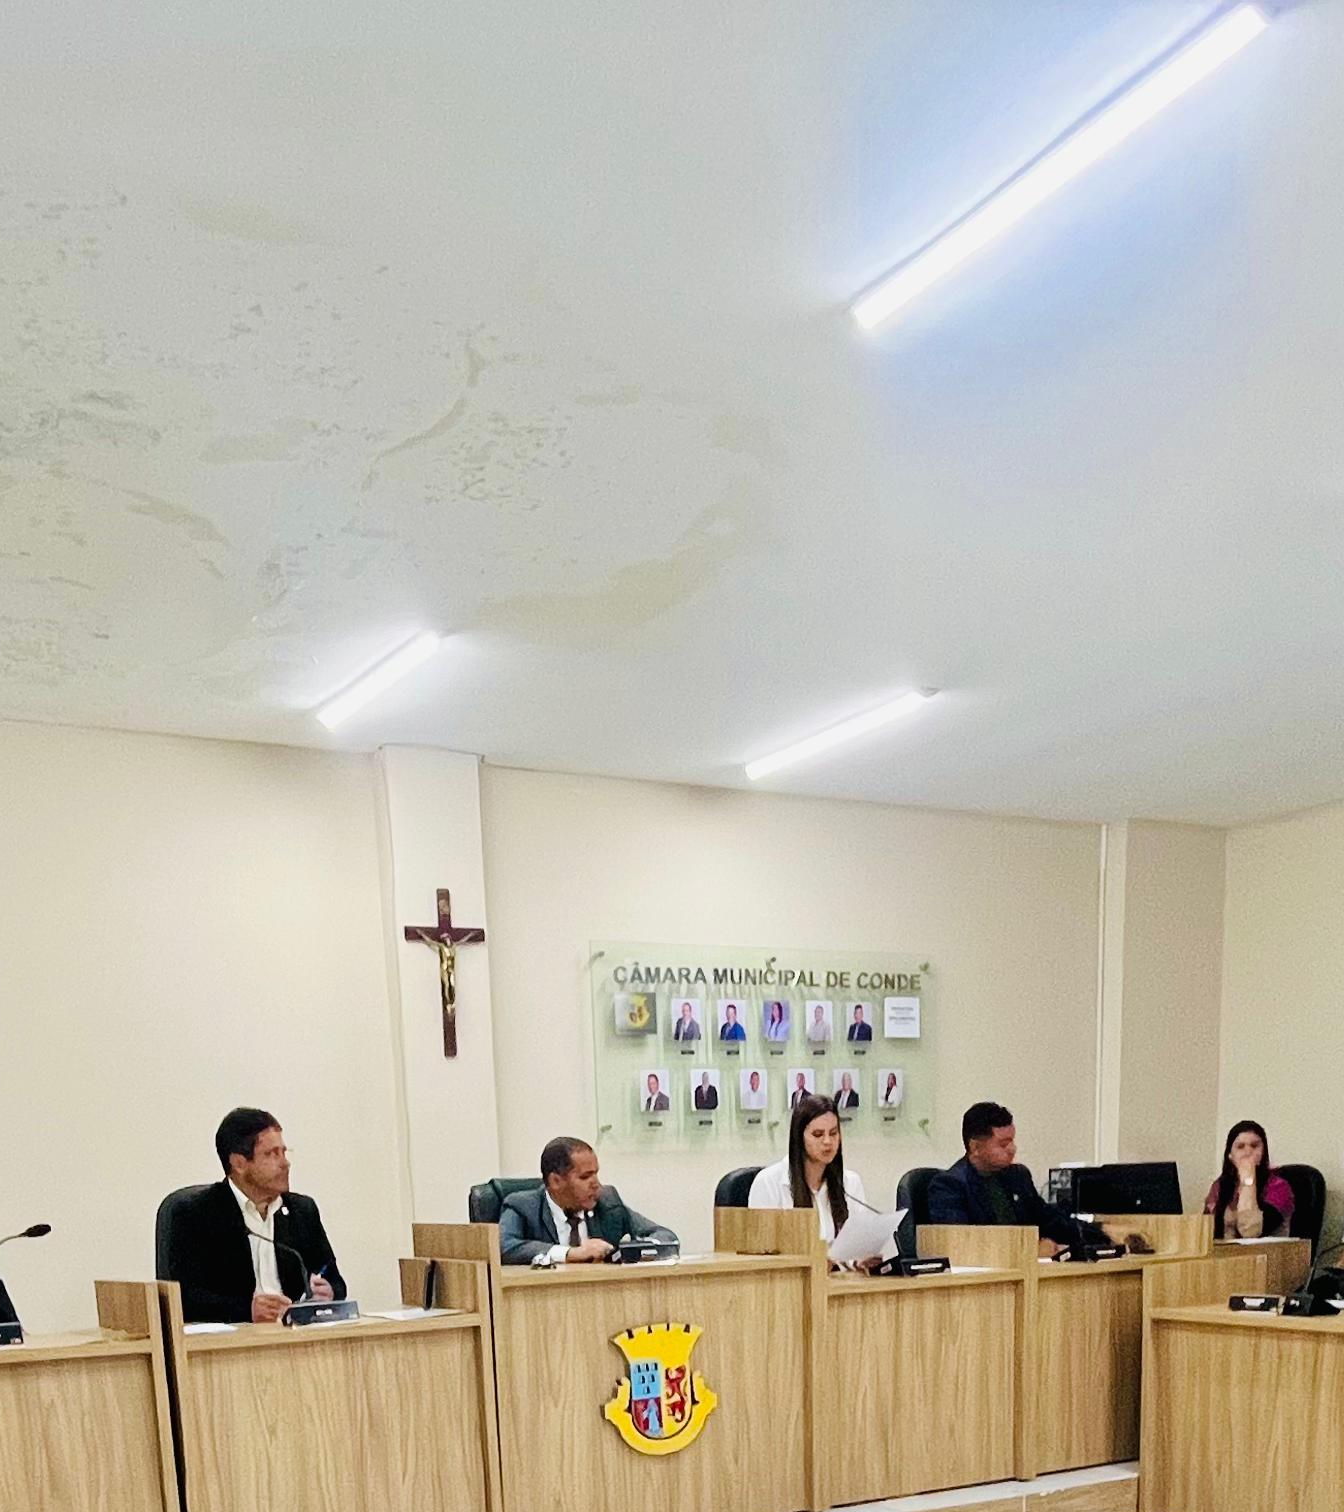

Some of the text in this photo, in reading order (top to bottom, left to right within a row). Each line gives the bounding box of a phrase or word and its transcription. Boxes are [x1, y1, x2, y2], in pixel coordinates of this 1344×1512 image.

[613, 961, 921, 991] CÂMARA MUNICIPAL DE CONDE
